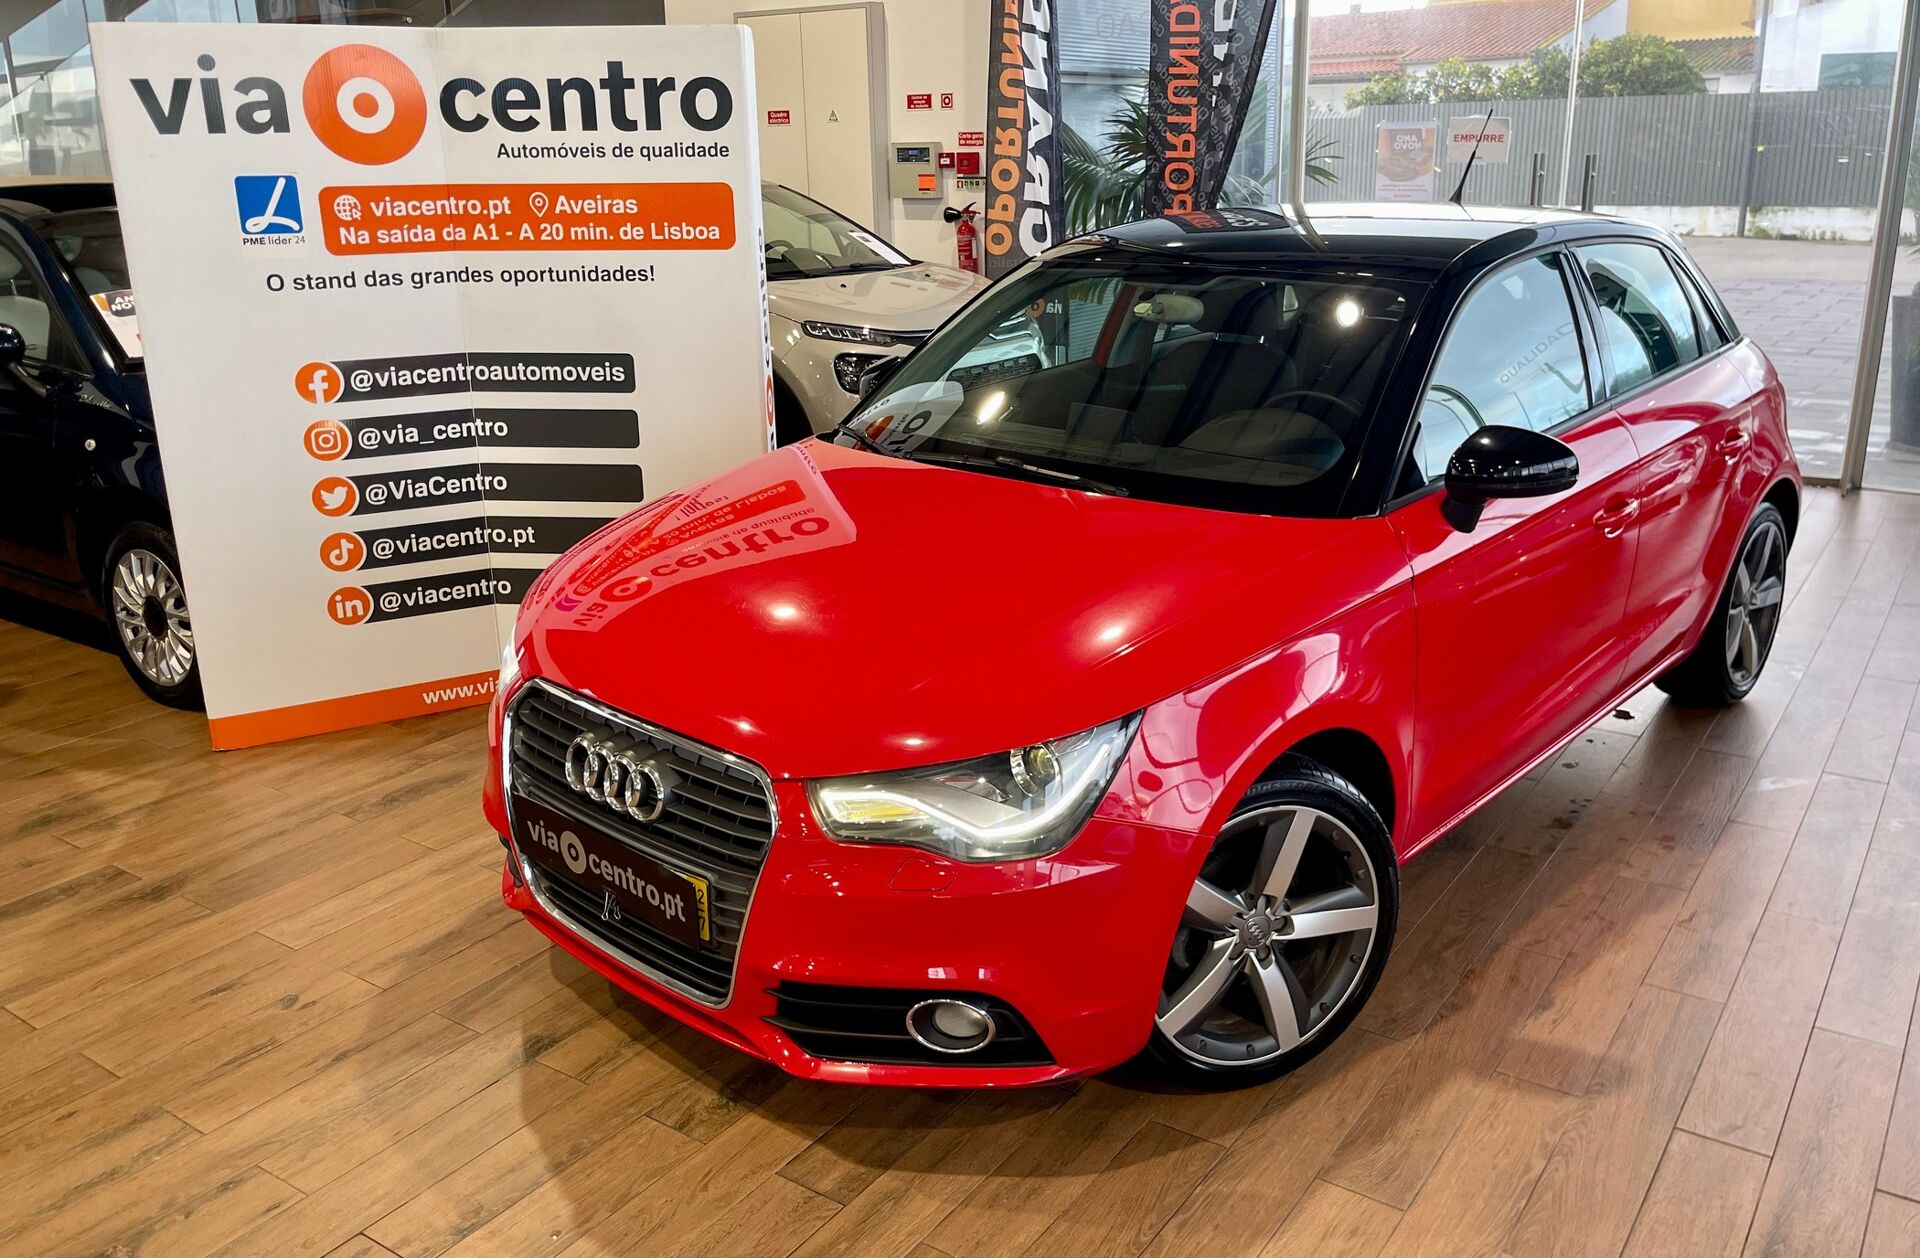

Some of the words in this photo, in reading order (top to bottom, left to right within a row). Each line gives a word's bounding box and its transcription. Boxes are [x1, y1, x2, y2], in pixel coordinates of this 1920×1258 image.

[129, 54, 291, 135] via
[440, 61, 733, 132] centro
[497, 142, 606, 159] Automóveis
[612, 143, 635, 158] de
[640, 142, 730, 162] qualidade
[1453, 134, 1504, 143] EMPURRE
[370, 196, 512, 219] viacentro.pt
[555, 195, 638, 214] Aveiras
[243, 237, 266, 246] PME
[339, 226, 370, 245] Na
[376, 224, 436, 244] saída
[442, 223, 467, 241] da
[473, 223, 500, 241] A1
[519, 223, 535, 241] A
[540, 223, 564, 241] 20
[570, 222, 614, 241] min.
[619, 222, 645, 240] de
[651, 222, 720, 240] Lisboa
[266, 274, 285, 292] O
[293, 271, 357, 291] stand
[364, 270, 404, 288] das
[411, 266, 494, 290] grandes
[500, 265, 655, 287] oportunidades!
[350, 362, 626, 392] @viacentroautomoveis
[358, 418, 509, 450] @via_centro
[365, 473, 508, 505] @ViaCentro
[372, 526, 536, 559] @viacentro.pt
[379, 579, 512, 613] @viacentro
[527, 820, 559, 853] via
[588, 853, 687, 923] centro.pt
